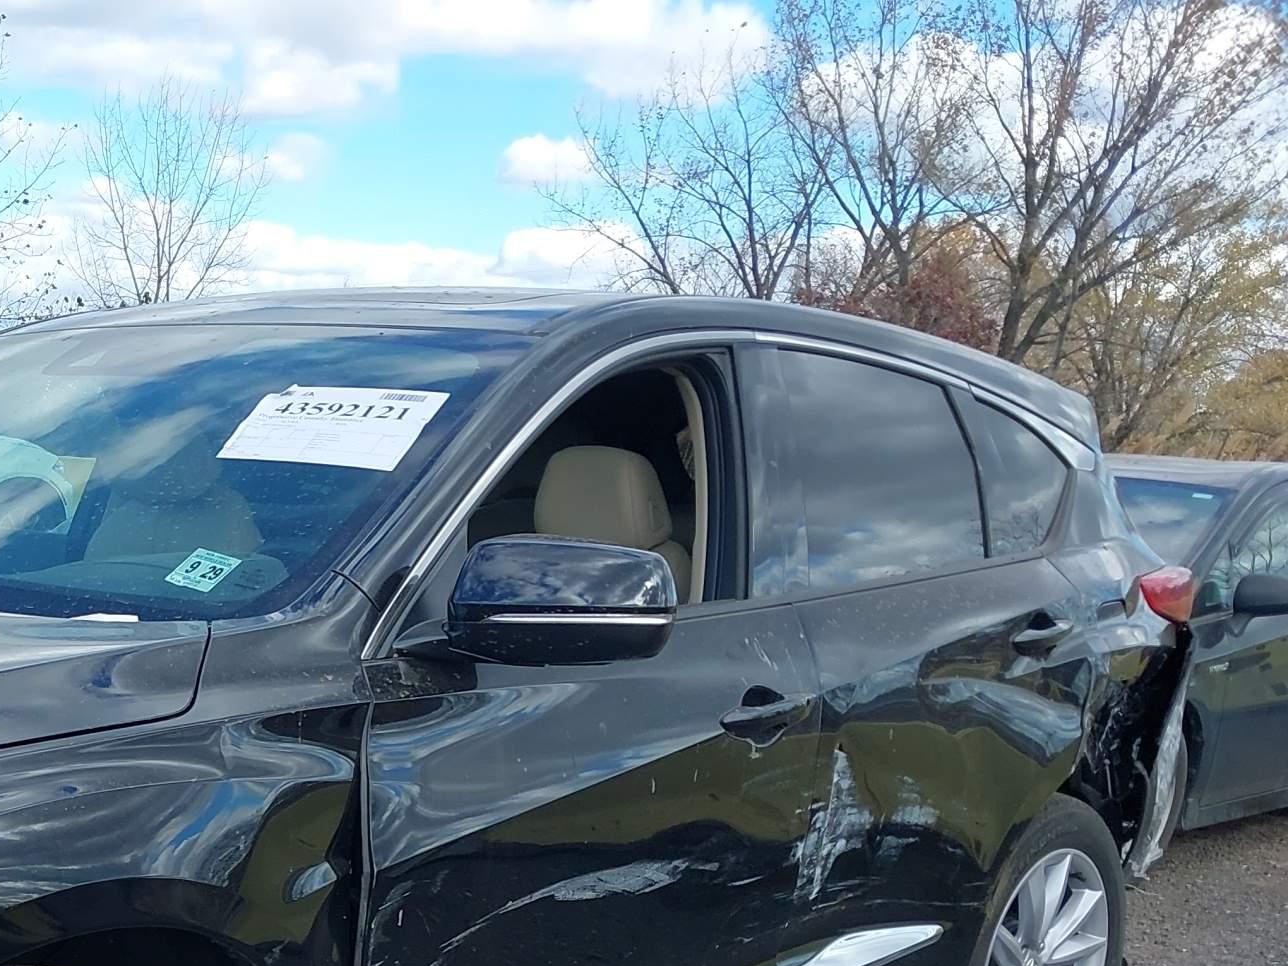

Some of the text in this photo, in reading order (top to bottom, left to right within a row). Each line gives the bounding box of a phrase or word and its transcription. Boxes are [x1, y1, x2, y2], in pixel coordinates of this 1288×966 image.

[274, 401, 411, 421] 43592121
[185, 560, 201, 574] 9
[199, 565, 224, 581] 29
